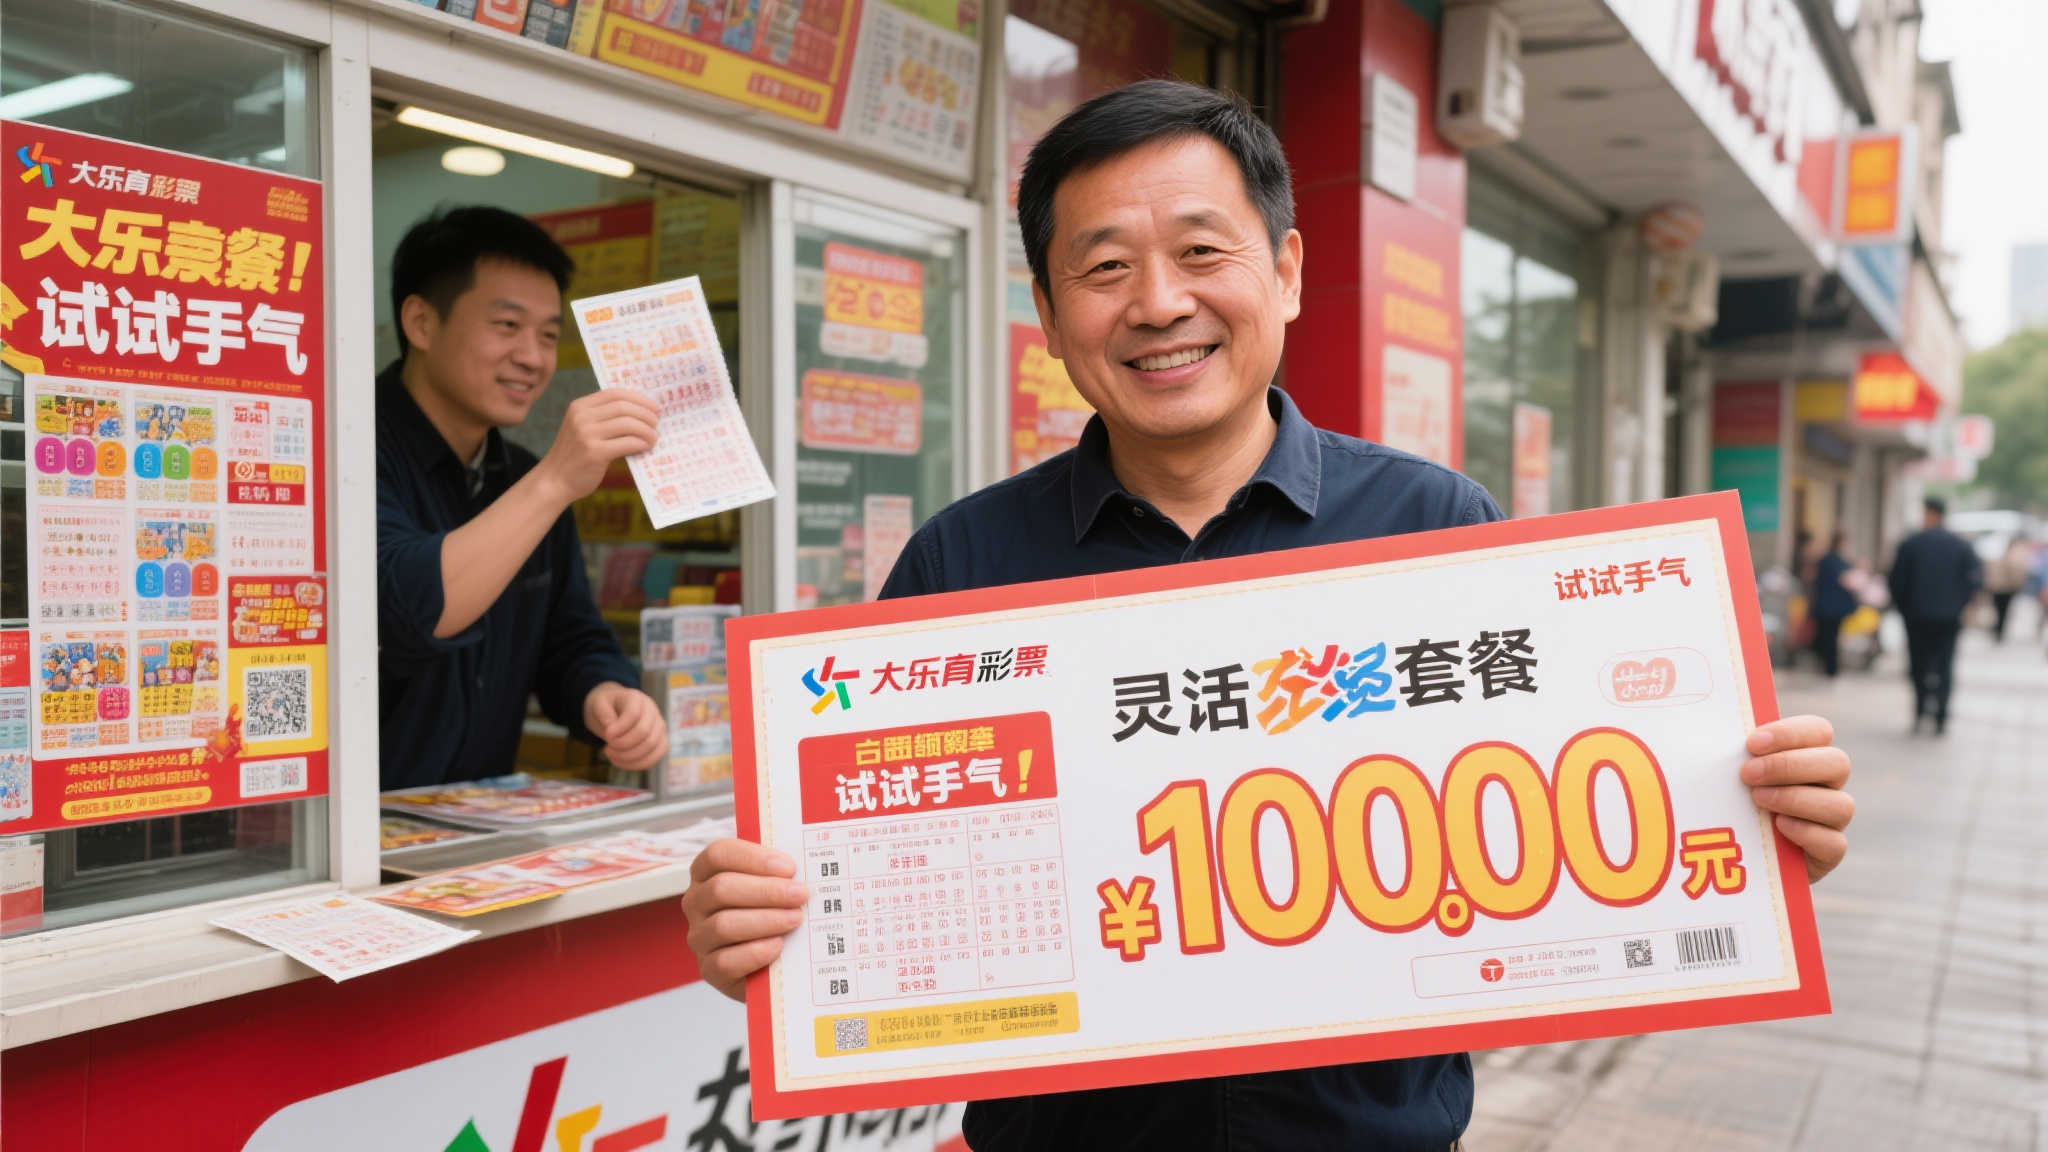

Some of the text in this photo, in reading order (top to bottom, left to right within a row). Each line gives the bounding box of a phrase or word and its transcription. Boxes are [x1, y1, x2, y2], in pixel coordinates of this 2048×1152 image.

[36, 276, 308, 376] 试试手气
[1554, 557, 1692, 601] 试试手气
[835, 749, 1033, 814] 试试手气!
